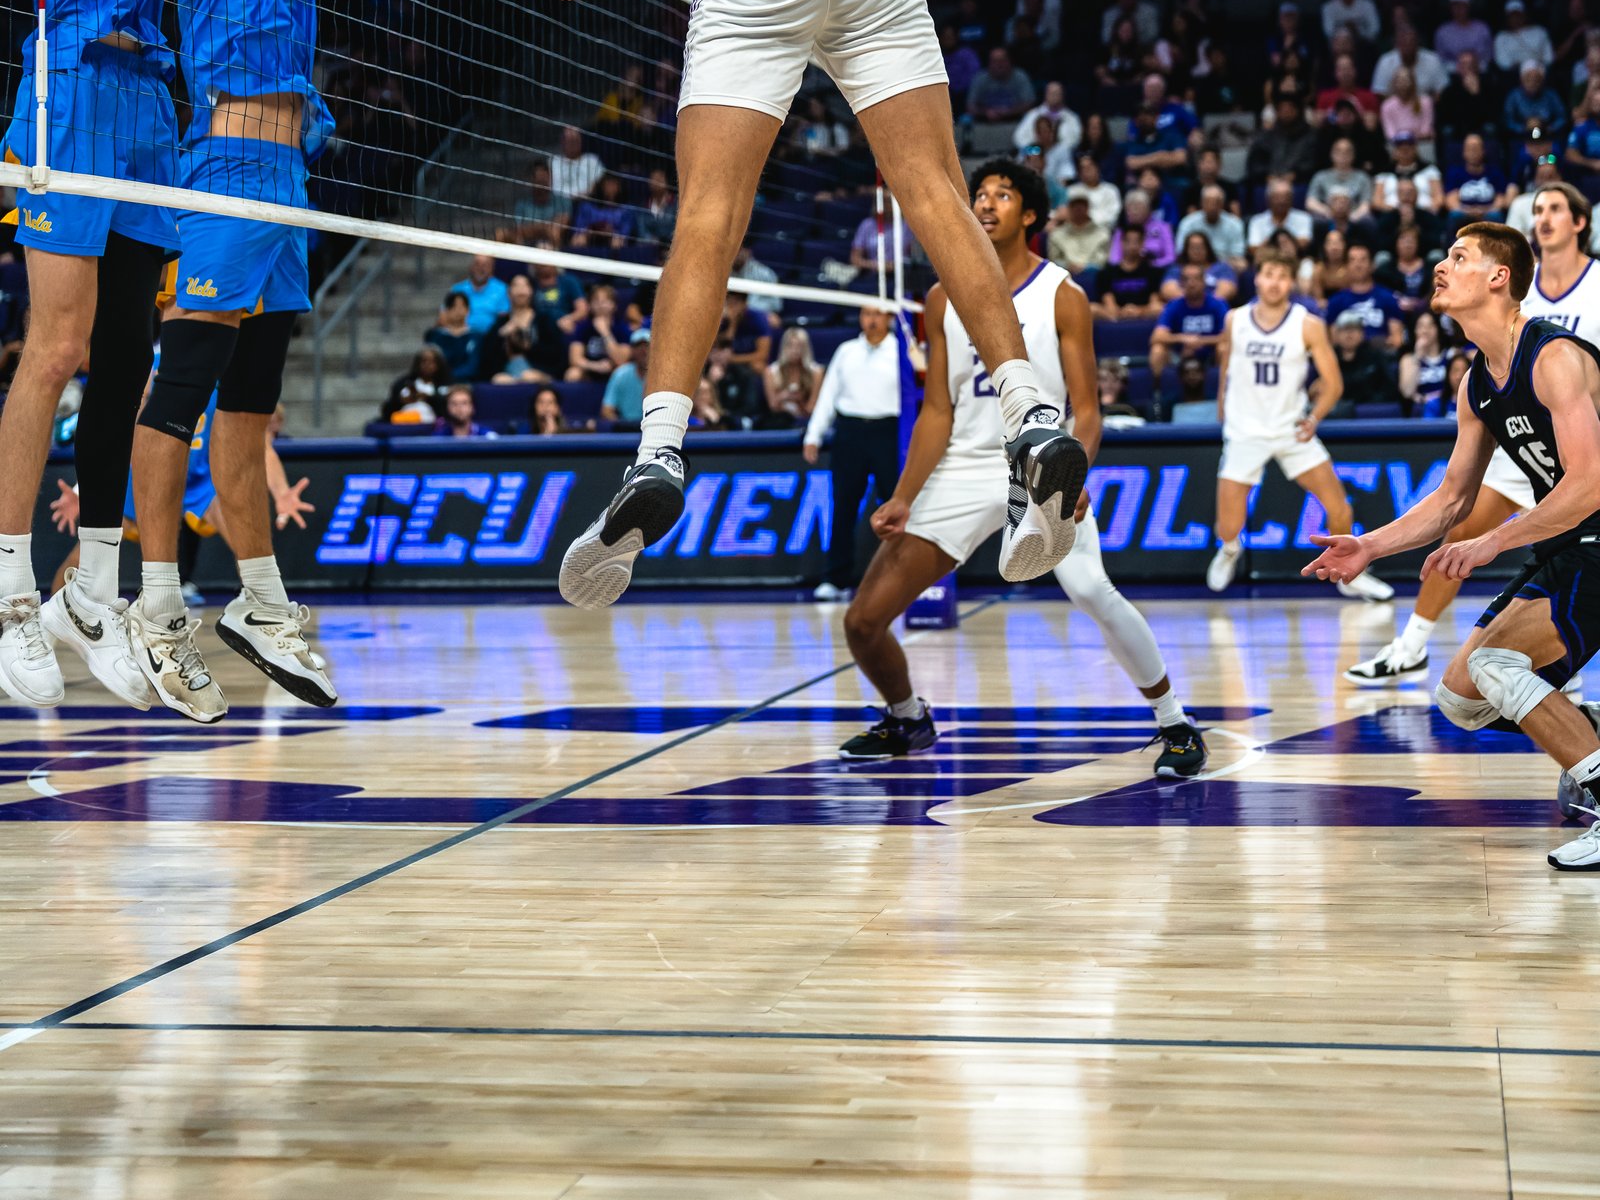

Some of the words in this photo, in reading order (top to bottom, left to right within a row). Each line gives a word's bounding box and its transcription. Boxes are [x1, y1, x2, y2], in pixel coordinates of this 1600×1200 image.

[1245, 341, 1285, 358] GCU
[973, 354, 999, 398] 2
[1254, 361, 1279, 386] 10
[1505, 415, 1534, 439] GCU
[316, 471, 578, 565] GCU
